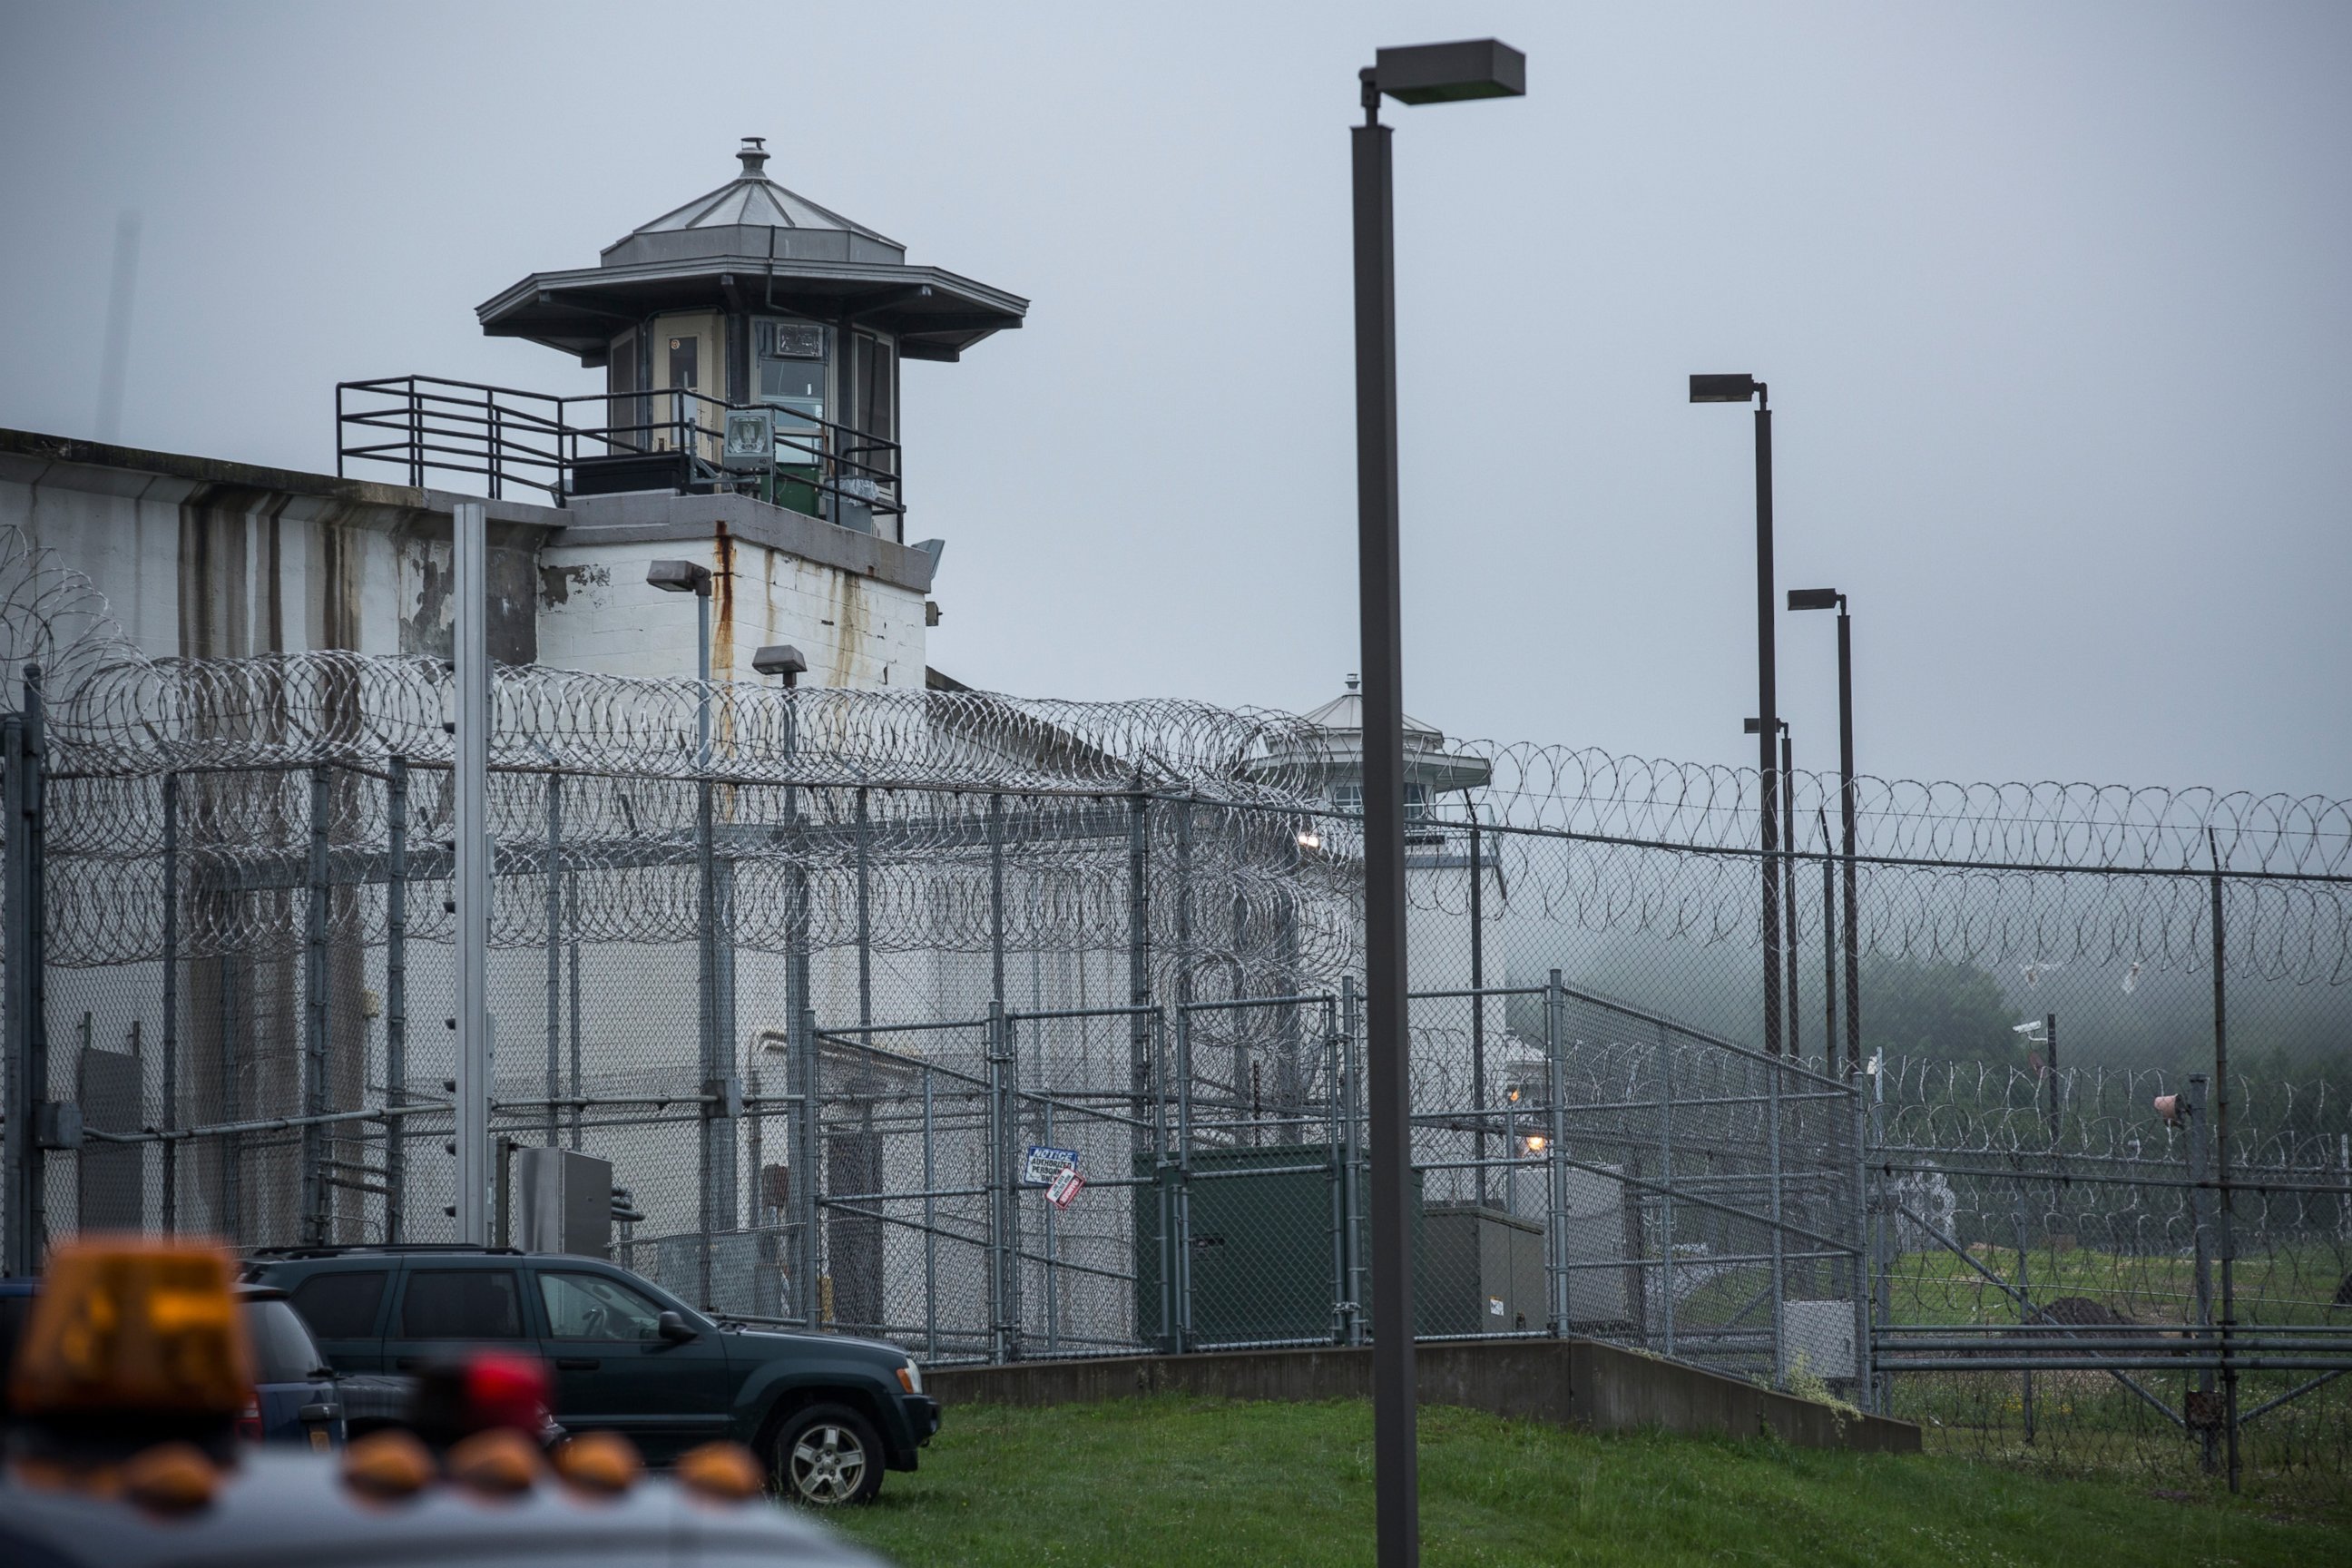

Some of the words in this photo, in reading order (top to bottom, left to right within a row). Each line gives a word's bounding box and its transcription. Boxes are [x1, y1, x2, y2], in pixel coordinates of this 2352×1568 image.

[1034, 1149, 1073, 1161] NOTICE
[1032, 1158, 1072, 1168] AUTHORIZED
[1032, 1166, 1061, 1175] PERSONN
[1061, 1179, 1079, 1203] DANGER
